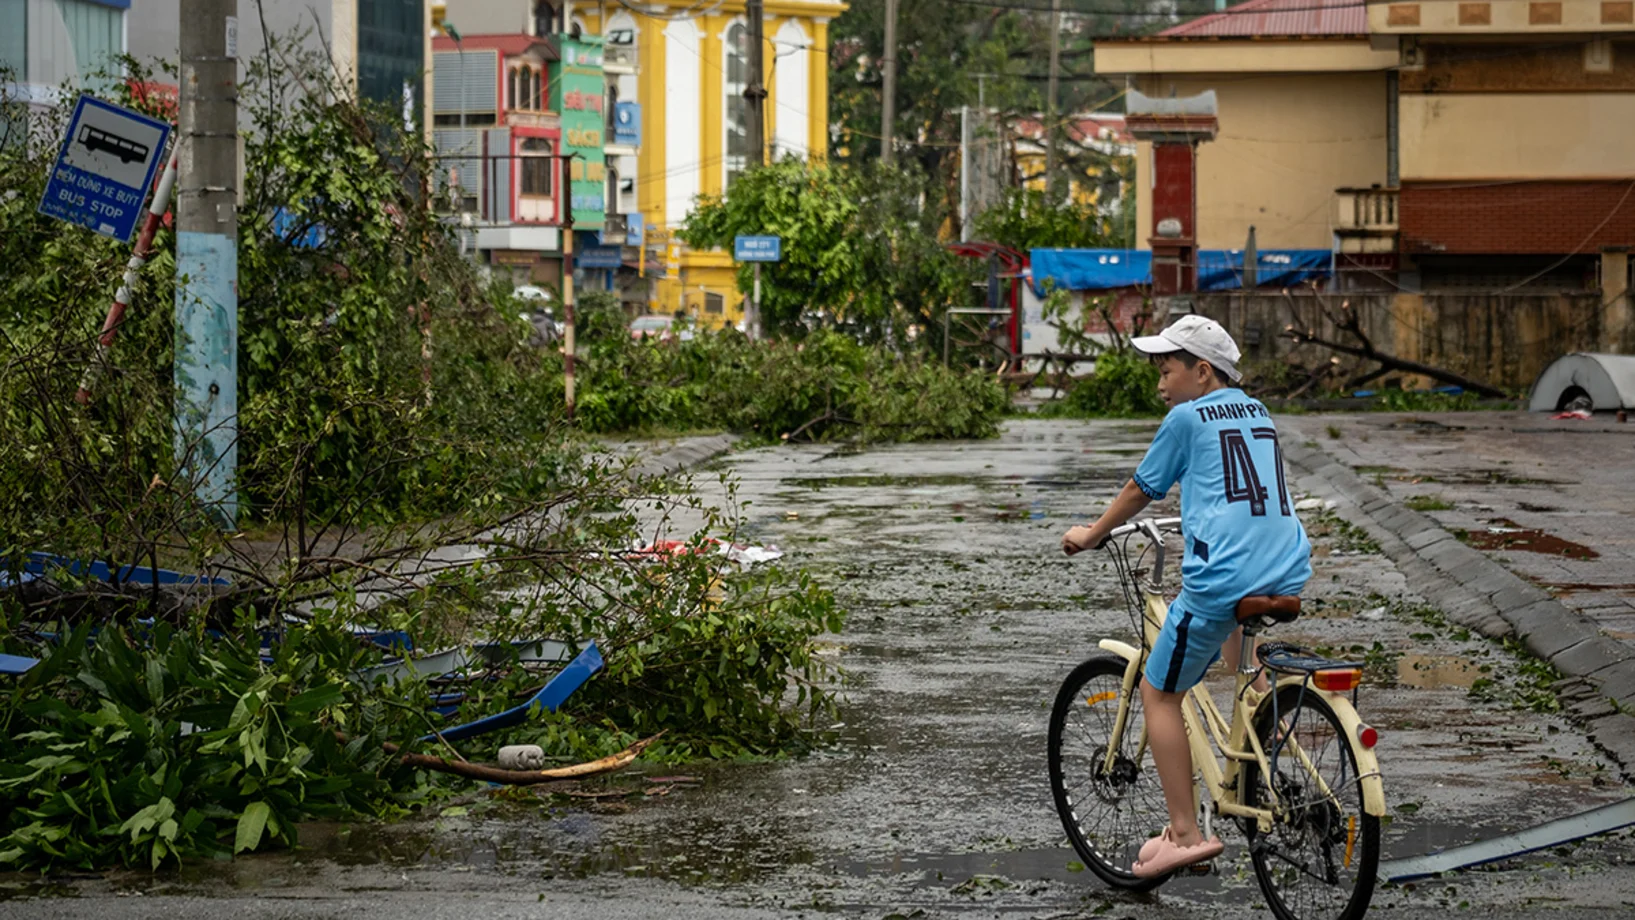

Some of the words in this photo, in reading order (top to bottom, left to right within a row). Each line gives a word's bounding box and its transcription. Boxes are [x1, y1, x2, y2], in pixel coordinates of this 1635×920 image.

[58, 188, 86, 207] BUS
[89, 199, 124, 219] STOP
[103, 185, 115, 198] XE
[1196, 403, 1248, 423] THANH
[1246, 403, 1272, 419] PH
[1219, 427, 1291, 517] 47
